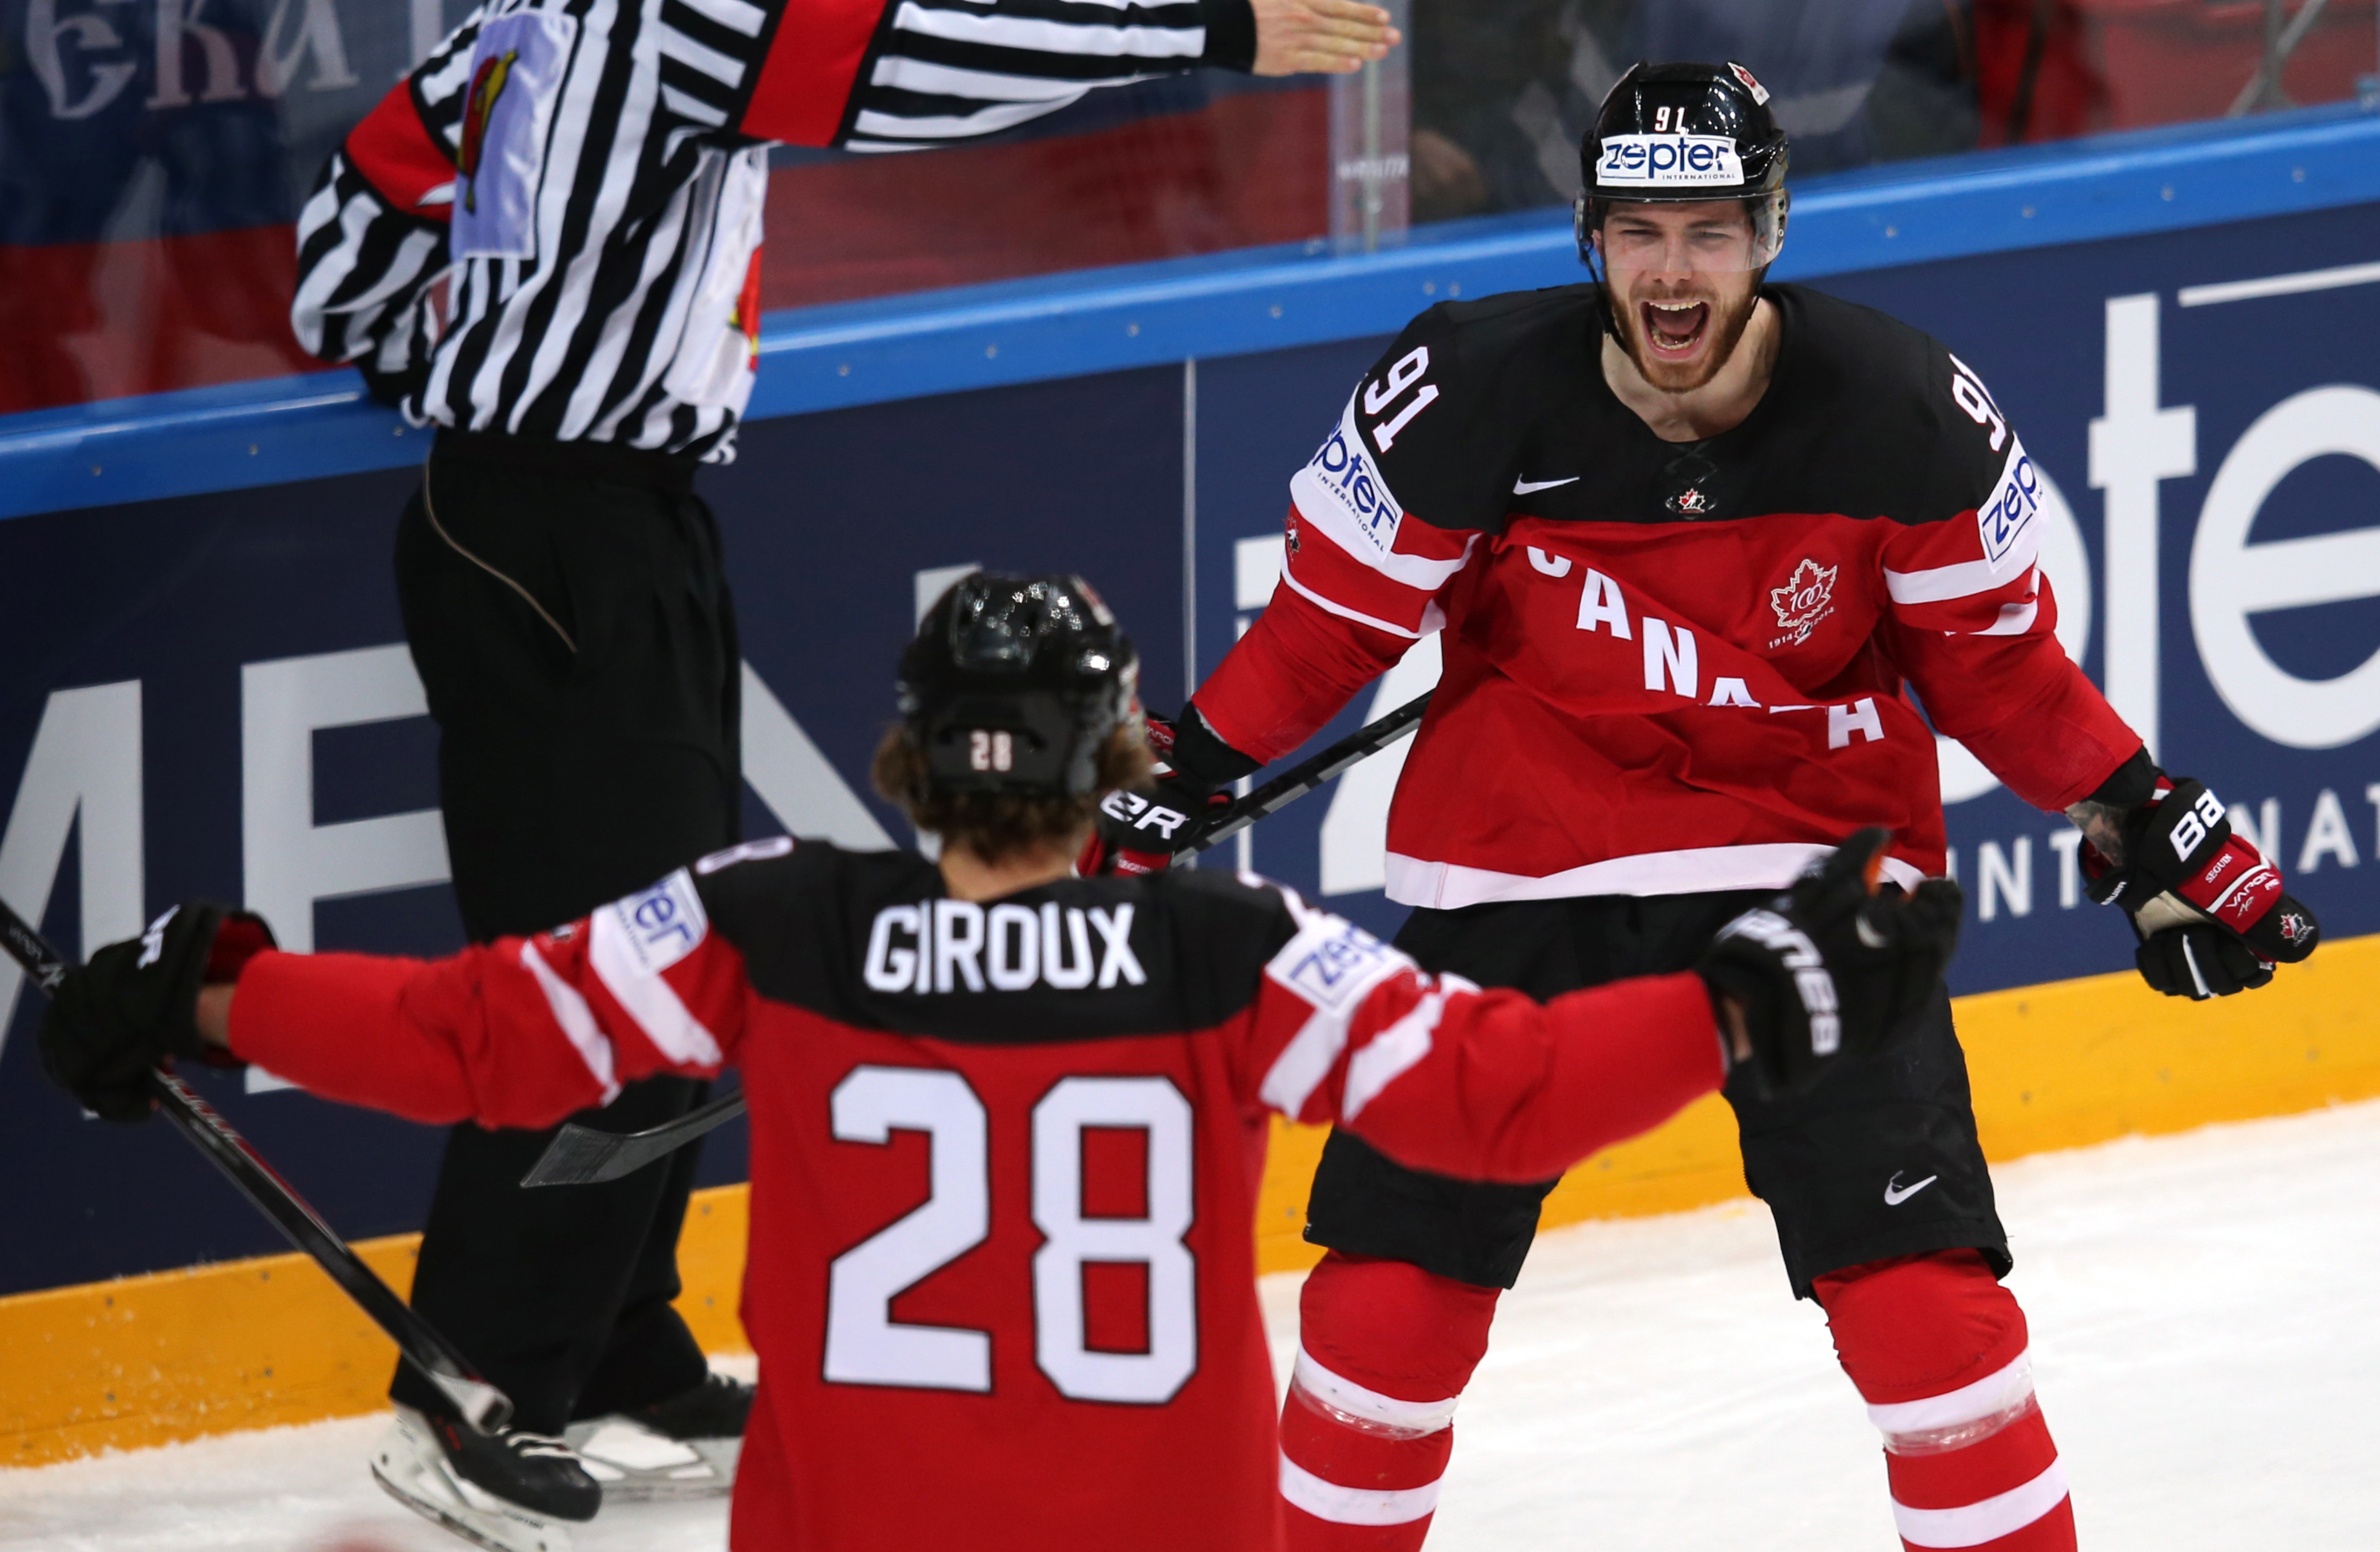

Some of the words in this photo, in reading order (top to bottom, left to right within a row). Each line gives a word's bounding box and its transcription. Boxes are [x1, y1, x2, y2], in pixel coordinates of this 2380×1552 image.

[1655, 106, 1685, 132] 91
[1605, 137, 1729, 179] zepter
[1365, 346, 1439, 453] 91
[1317, 472, 1385, 552] INTERNATIONAL
[1769, 633, 1793, 648] 1914
[969, 728, 1013, 773] 28
[2205, 853, 2233, 884] SEGUIN
[2225, 872, 2275, 908] VAPOR
[864, 898, 1148, 995] GIROUX
[822, 1063, 1199, 1406] 28
